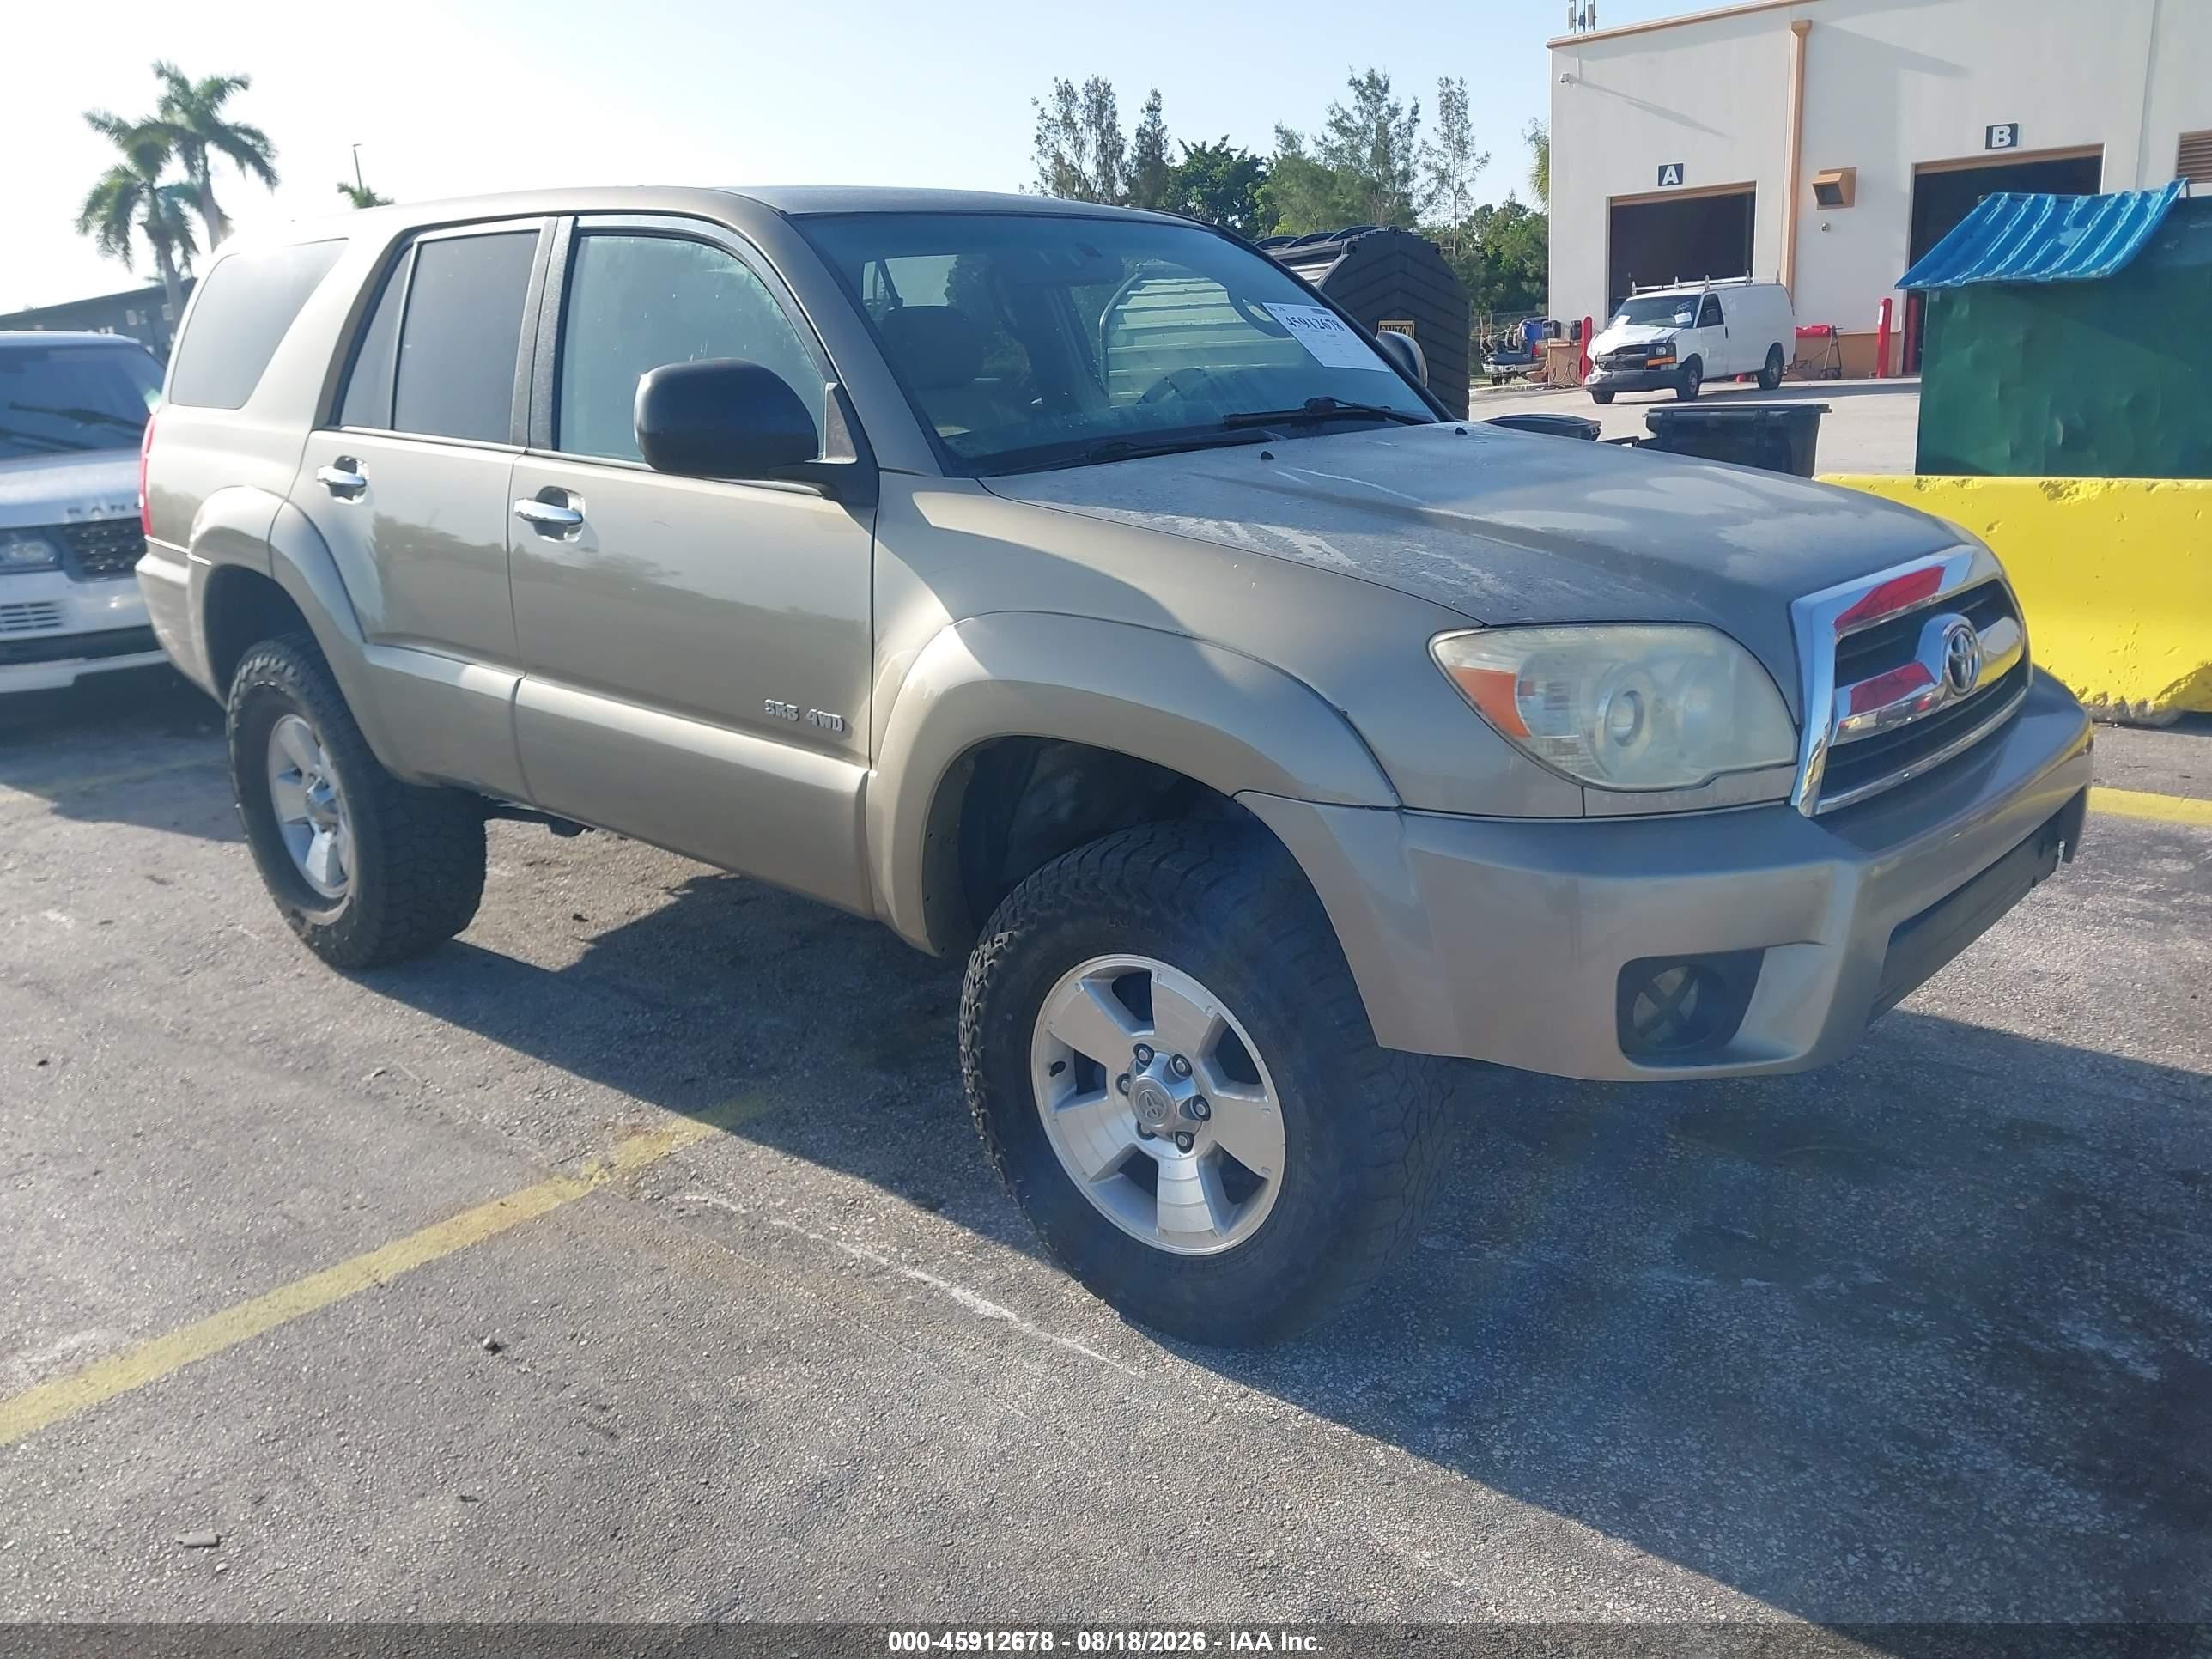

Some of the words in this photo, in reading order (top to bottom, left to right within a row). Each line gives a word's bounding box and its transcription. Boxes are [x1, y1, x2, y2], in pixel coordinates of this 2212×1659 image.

[1992, 125, 2011, 148] B
[1662, 165, 1680, 185] A
[1285, 315, 1345, 332] 45912678
[764, 698, 799, 721] SR5
[805, 708, 845, 732] 4WD
